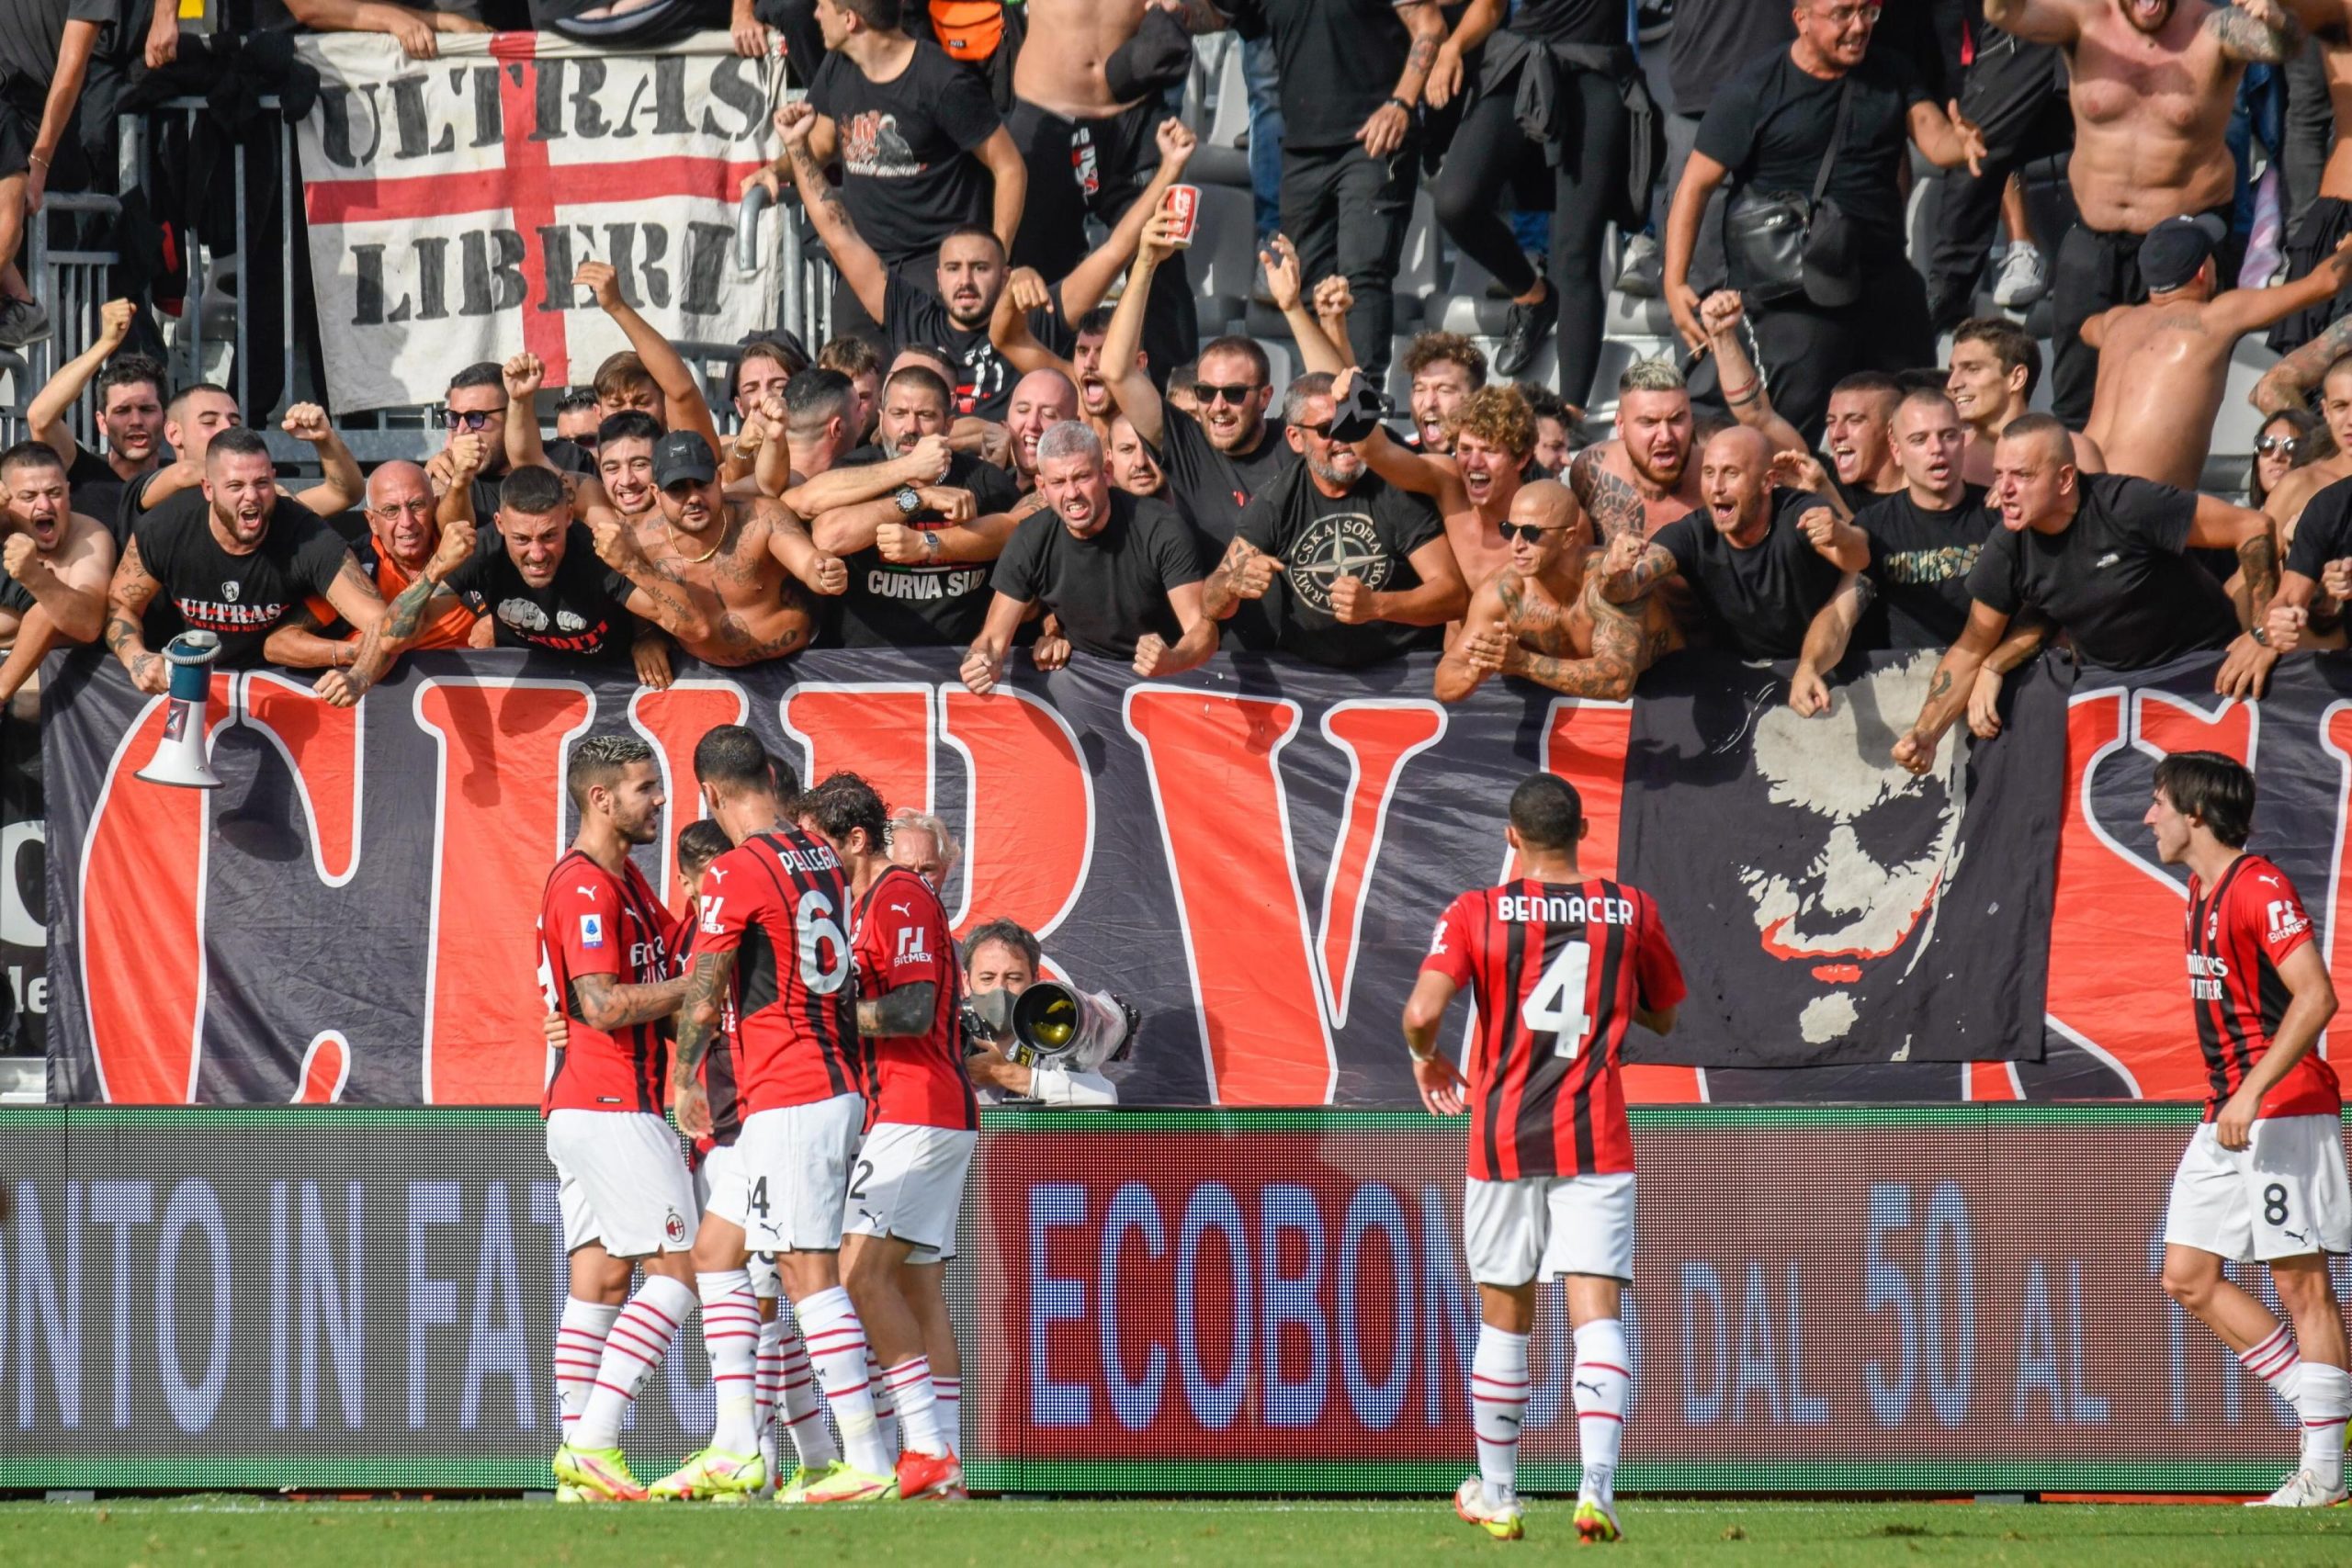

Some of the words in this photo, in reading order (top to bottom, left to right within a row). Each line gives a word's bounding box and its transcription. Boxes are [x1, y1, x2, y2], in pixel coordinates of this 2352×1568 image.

[316, 52, 774, 169] ULTRAS
[349, 220, 735, 326] LIBERI
[1296, 524, 1335, 565] CSKA
[1342, 520, 1382, 555] SOFIA
[867, 570, 944, 600] CURVA
[947, 568, 988, 597] SUD
[180, 597, 283, 626] ULTRAS
[1497, 895, 1634, 926] BENNACER
[893, 952, 933, 967] BitMEX
[1521, 940, 1590, 1059] 4
[2263, 1183, 2289, 1226] 8
[0, 1177, 233, 1436] NTO
[269, 1179, 366, 1431] IN
[1681, 1259, 1830, 1427] DAL
[1864, 1179, 1976, 1428] 50
[2013, 1258, 2111, 1426] AL
